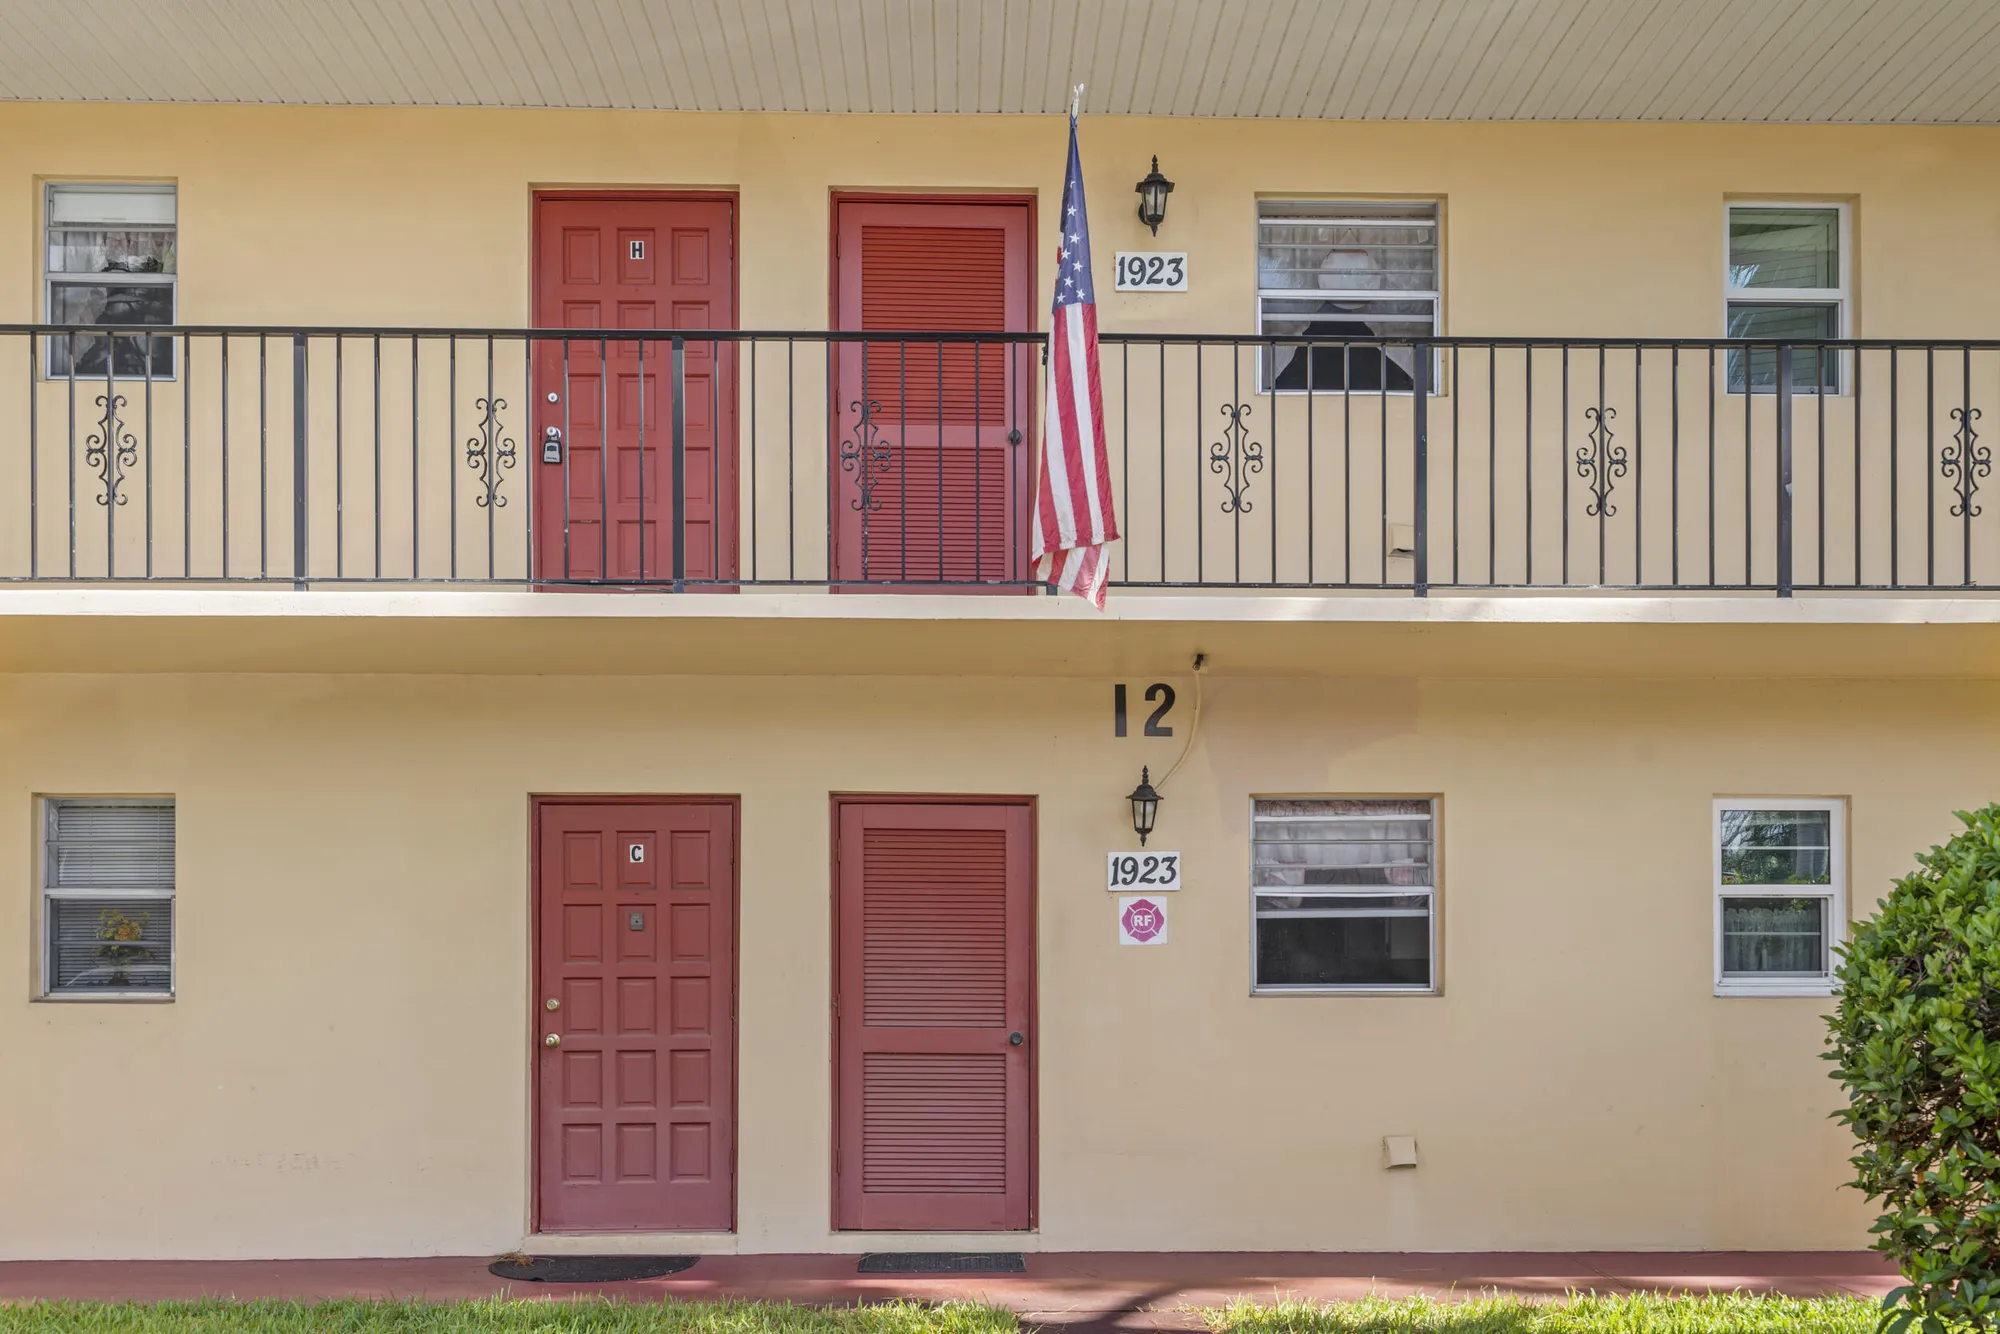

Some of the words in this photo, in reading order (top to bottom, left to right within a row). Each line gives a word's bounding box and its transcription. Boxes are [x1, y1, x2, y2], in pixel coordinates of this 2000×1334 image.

[632, 242, 643, 258] H
[1117, 256, 1184, 286] 1923
[1115, 683, 1175, 737] 12
[631, 845, 642, 861] C
[1110, 856, 1177, 886] 1923
[1133, 915, 1152, 927] RF
